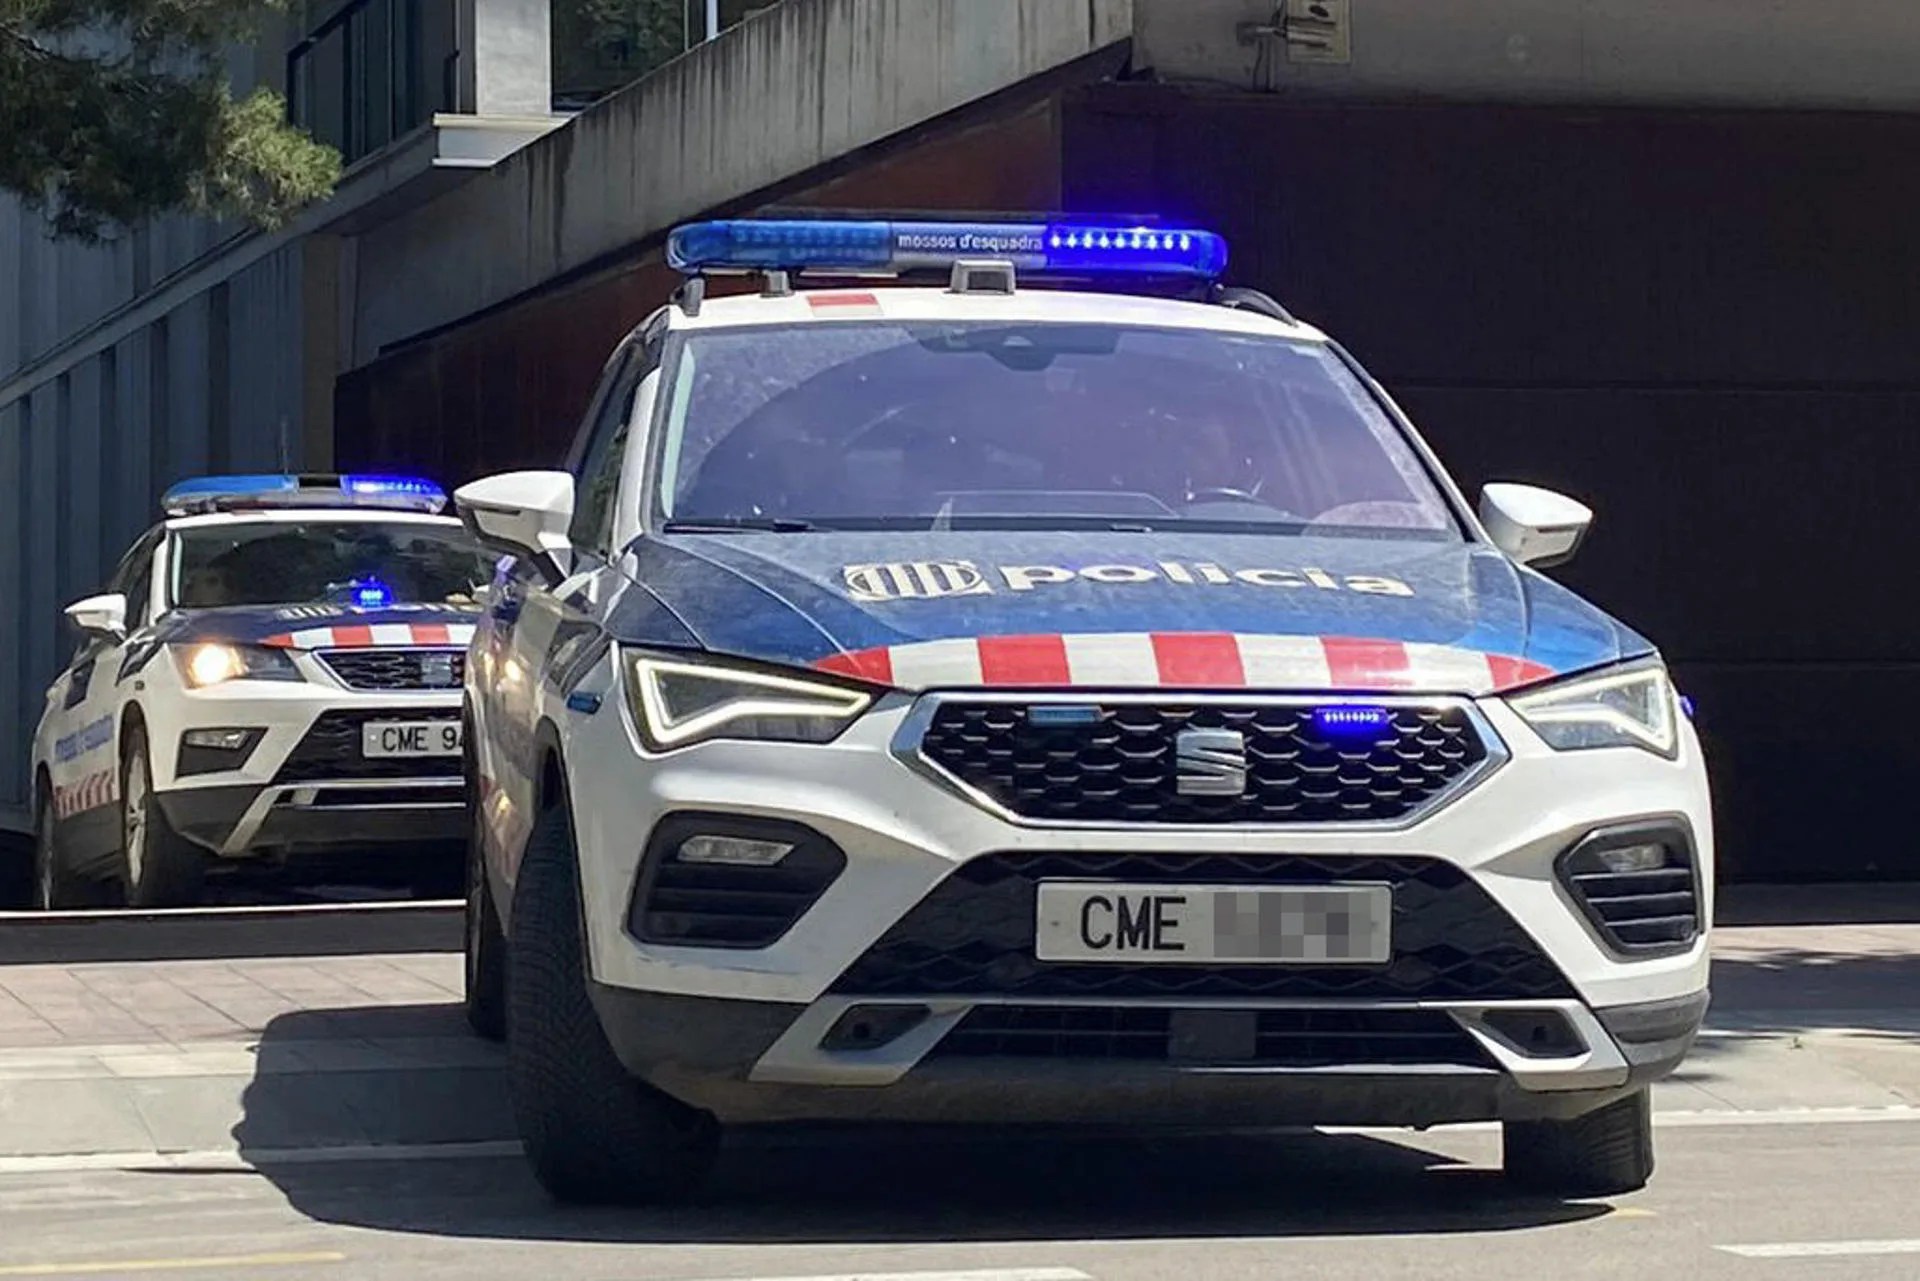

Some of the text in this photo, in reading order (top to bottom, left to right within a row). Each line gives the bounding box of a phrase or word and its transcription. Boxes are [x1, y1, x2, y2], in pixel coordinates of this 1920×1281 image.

[898, 234, 1043, 252] mossos d'esquadra
[1000, 561, 1415, 597] policia
[382, 726, 464, 752] CME 9
[1080, 896, 1187, 951] CME
